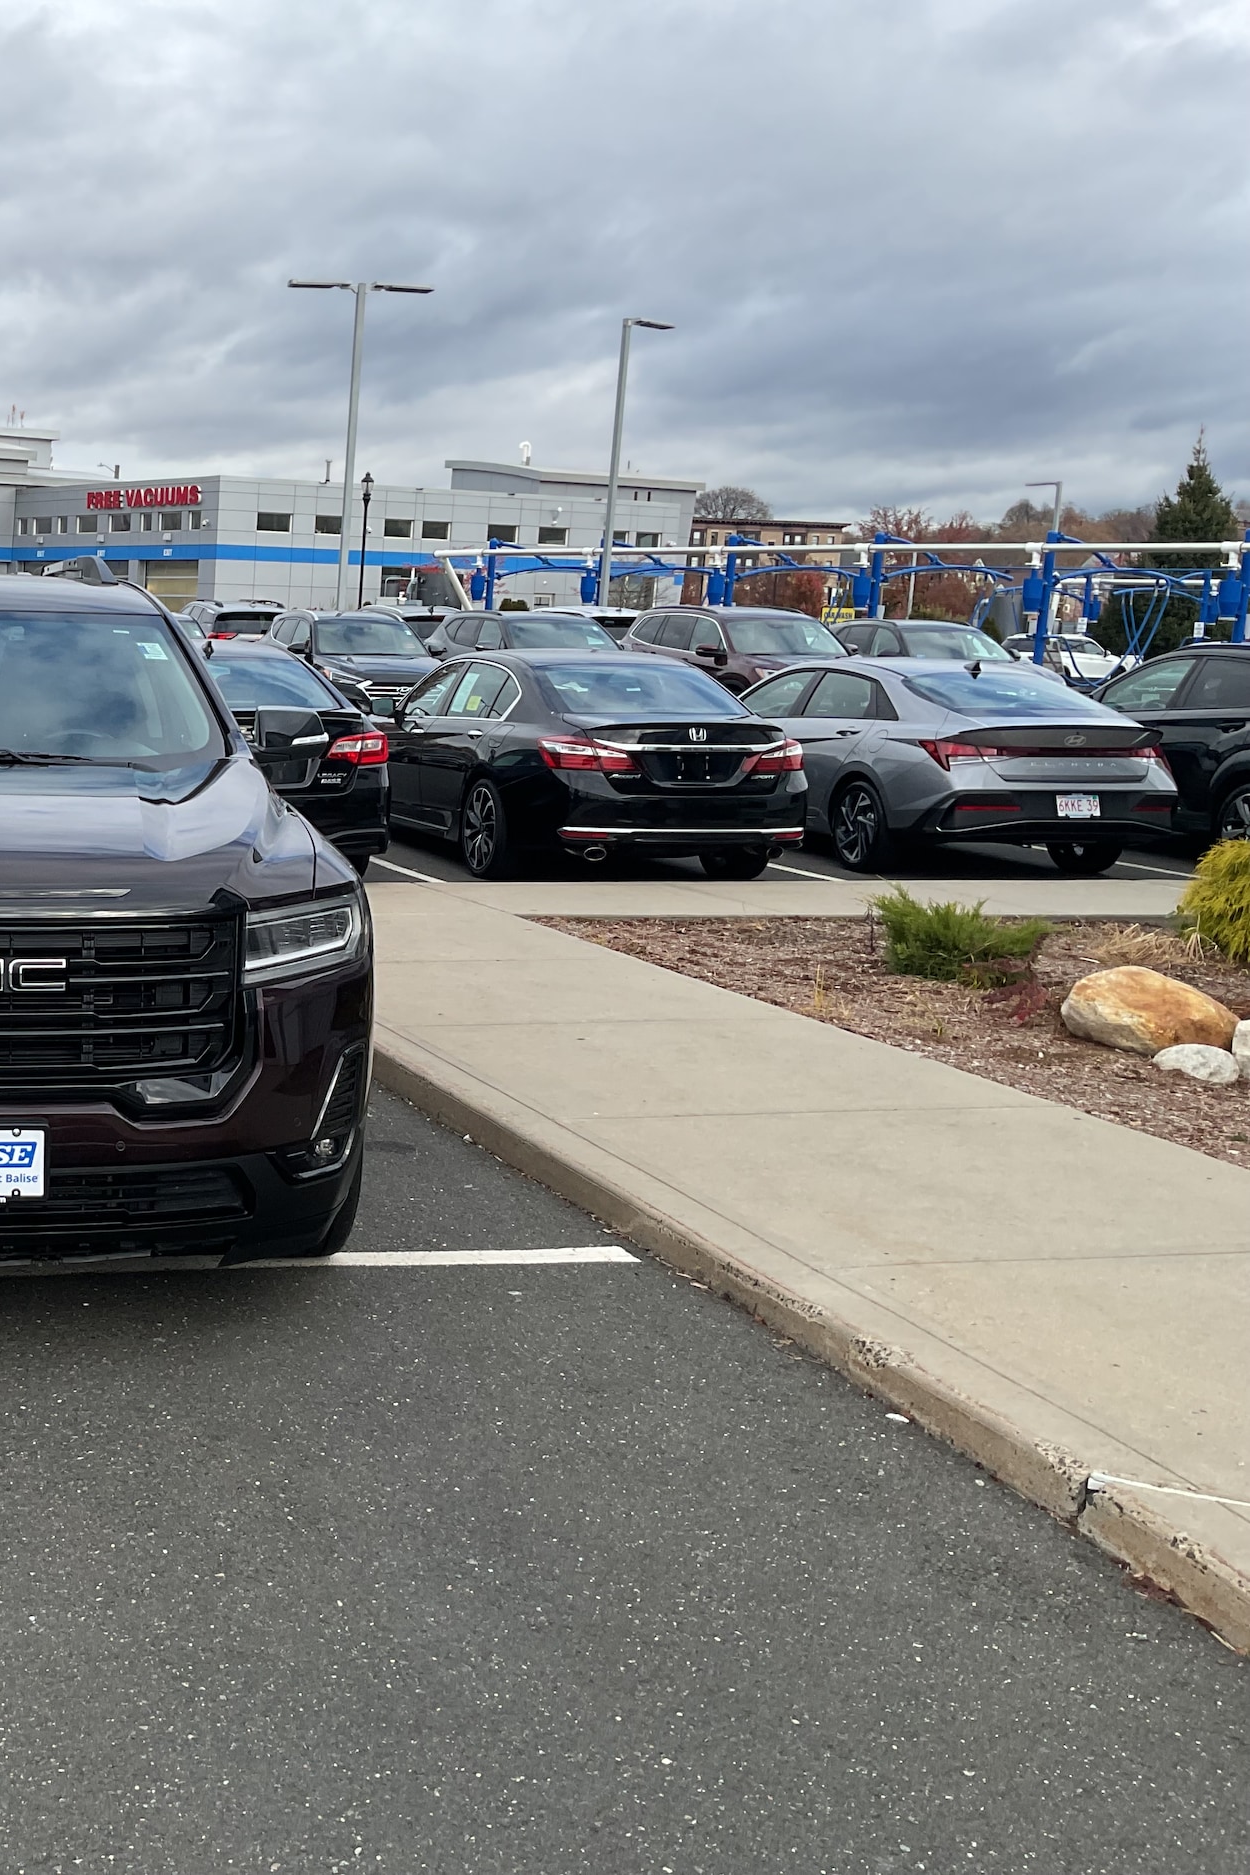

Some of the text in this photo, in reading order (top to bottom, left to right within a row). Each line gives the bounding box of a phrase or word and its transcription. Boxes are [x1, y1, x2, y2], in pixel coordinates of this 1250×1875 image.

[86, 485, 202, 510] FREE VACUUMS
[1058, 799, 1099, 812] 6KKE 39
[6, 1173, 38, 1183] Balise
